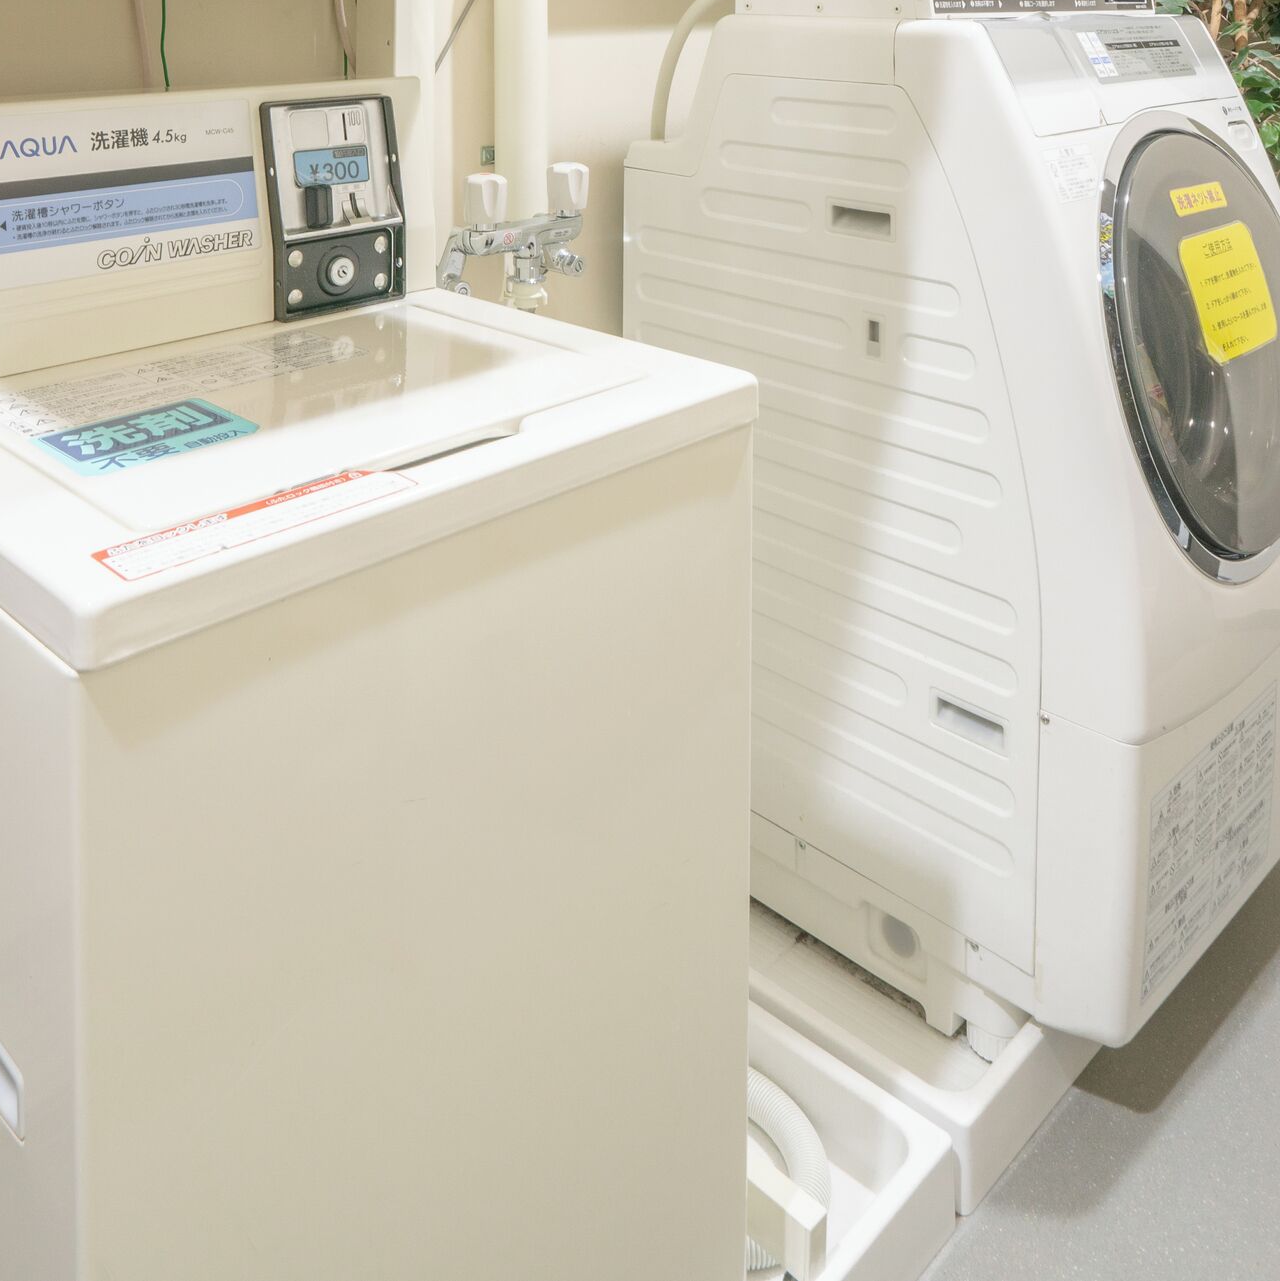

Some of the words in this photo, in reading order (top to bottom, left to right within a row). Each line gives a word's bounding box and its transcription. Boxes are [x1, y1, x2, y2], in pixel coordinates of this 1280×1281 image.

[347, 110, 361, 127] 100
[0, 134, 78, 160] AQUA
[90, 128, 149, 152] 洗濯機
[152, 129, 187, 144] 4.5kg
[309, 160, 360, 182] ¥300
[11, 196, 125, 222] 洗濯槽シャワーボタン
[167, 229, 253, 258] WASHER
[60, 406, 214, 457] 洗剤
[91, 443, 181, 470] 不要
[184, 428, 249, 450] 自動投入
